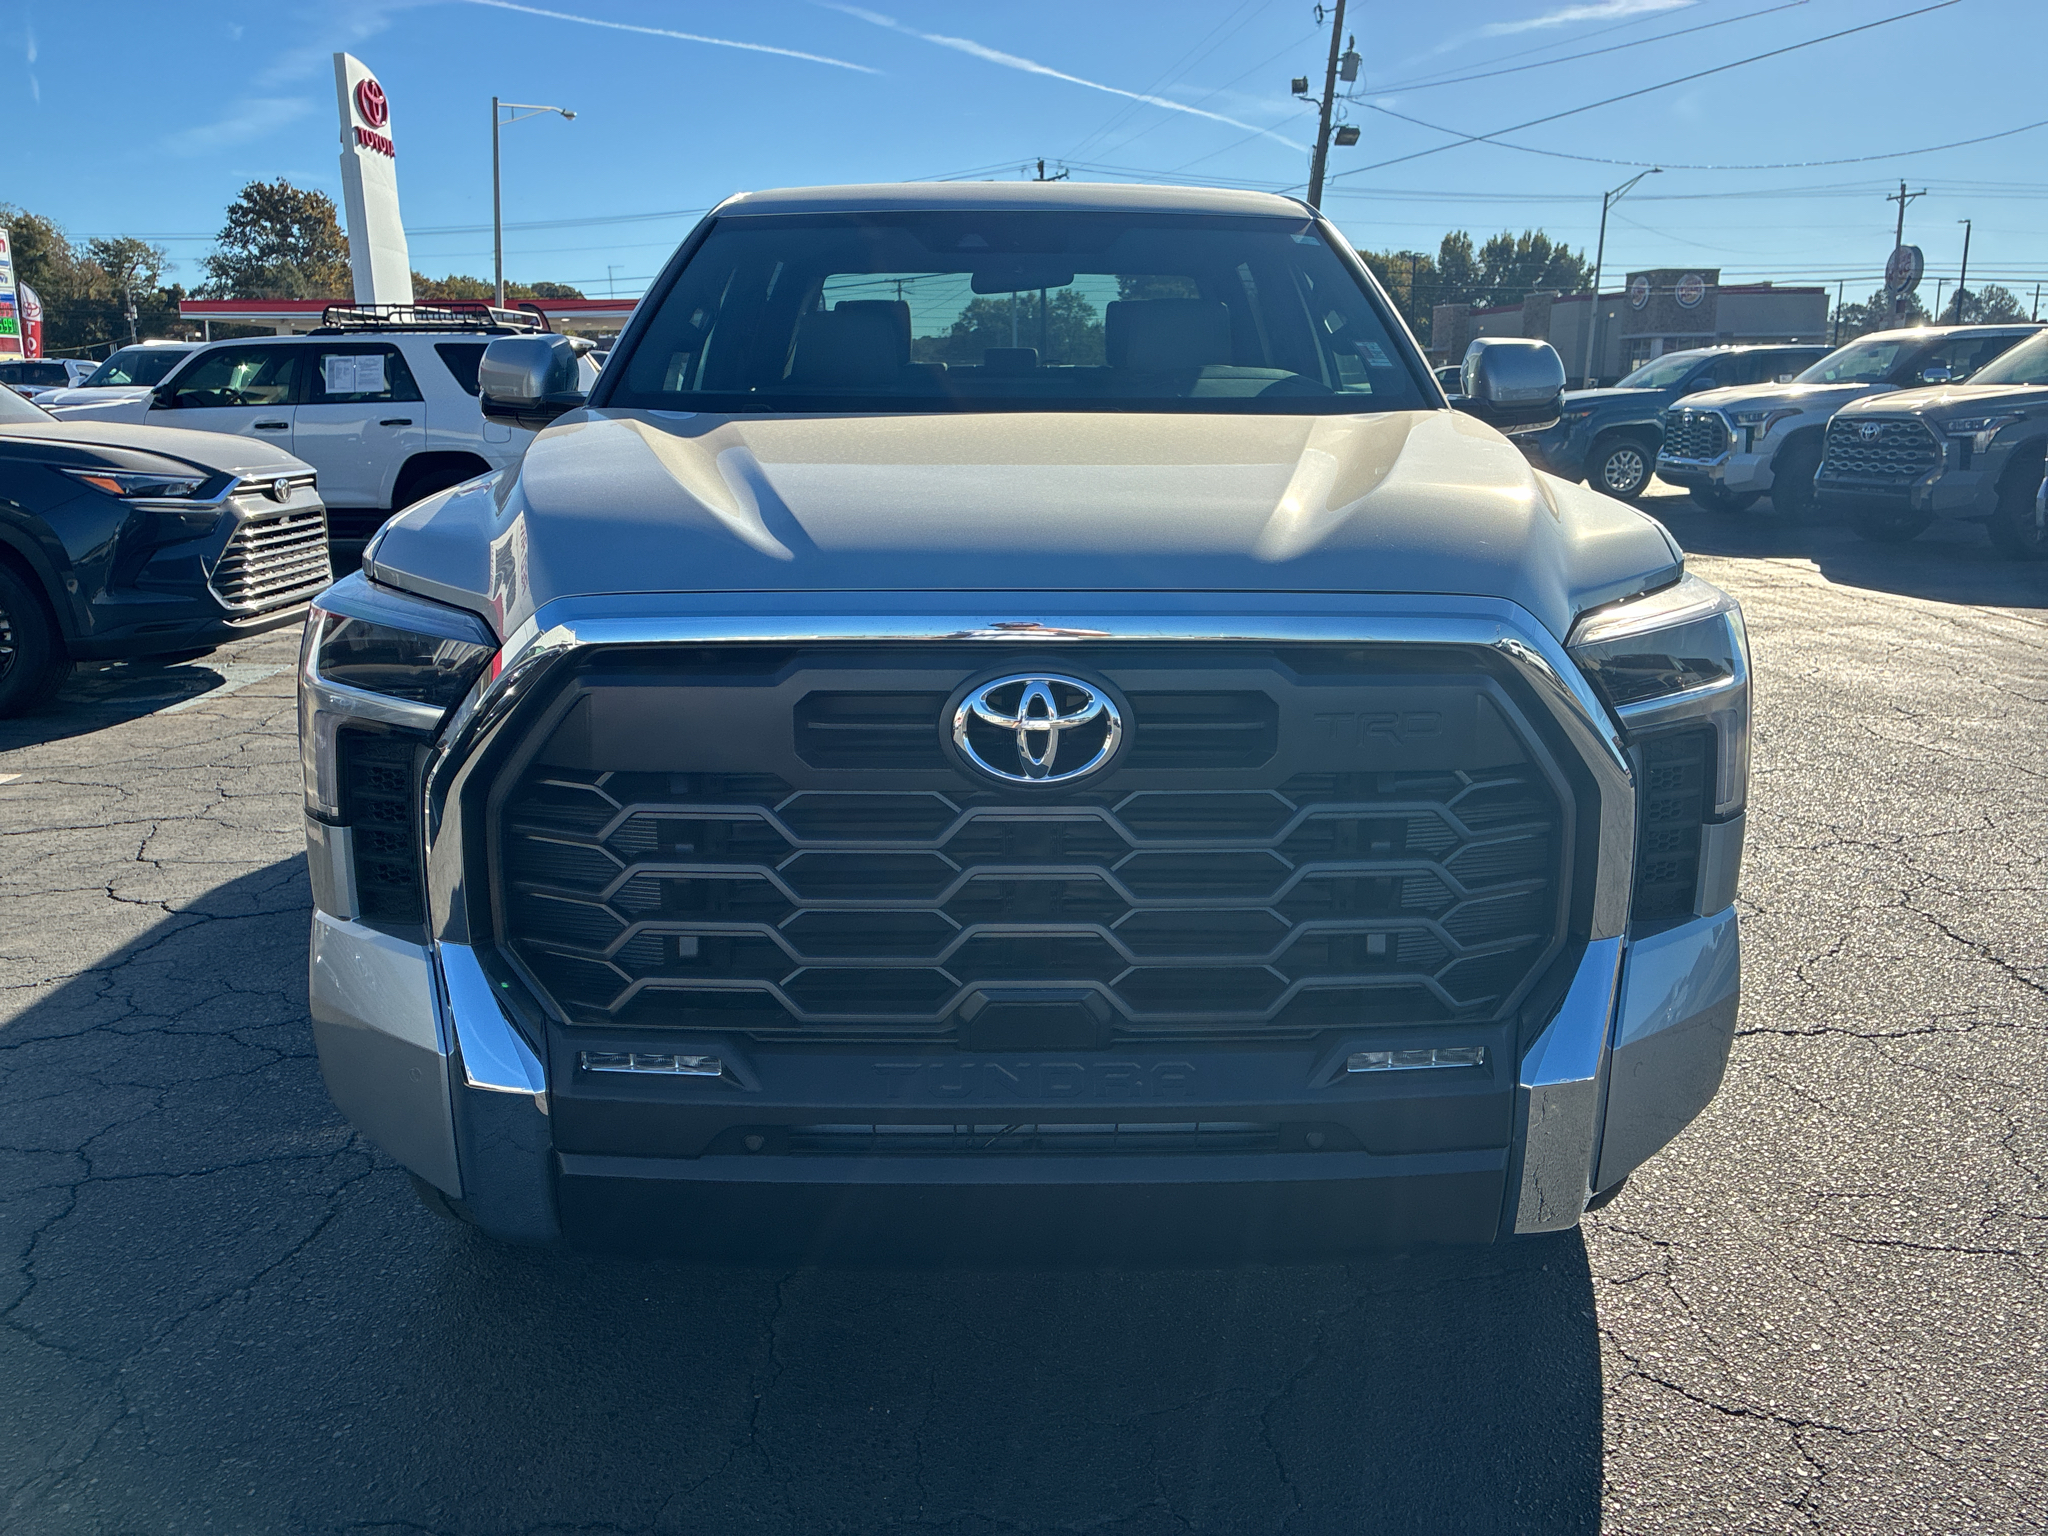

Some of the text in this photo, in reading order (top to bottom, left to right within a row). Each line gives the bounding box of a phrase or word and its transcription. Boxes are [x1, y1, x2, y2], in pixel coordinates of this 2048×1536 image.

[354, 126, 395, 157] TOYOTA
[1314, 711, 1442, 748] TRD
[872, 1062, 1197, 1099] TUNDRA
